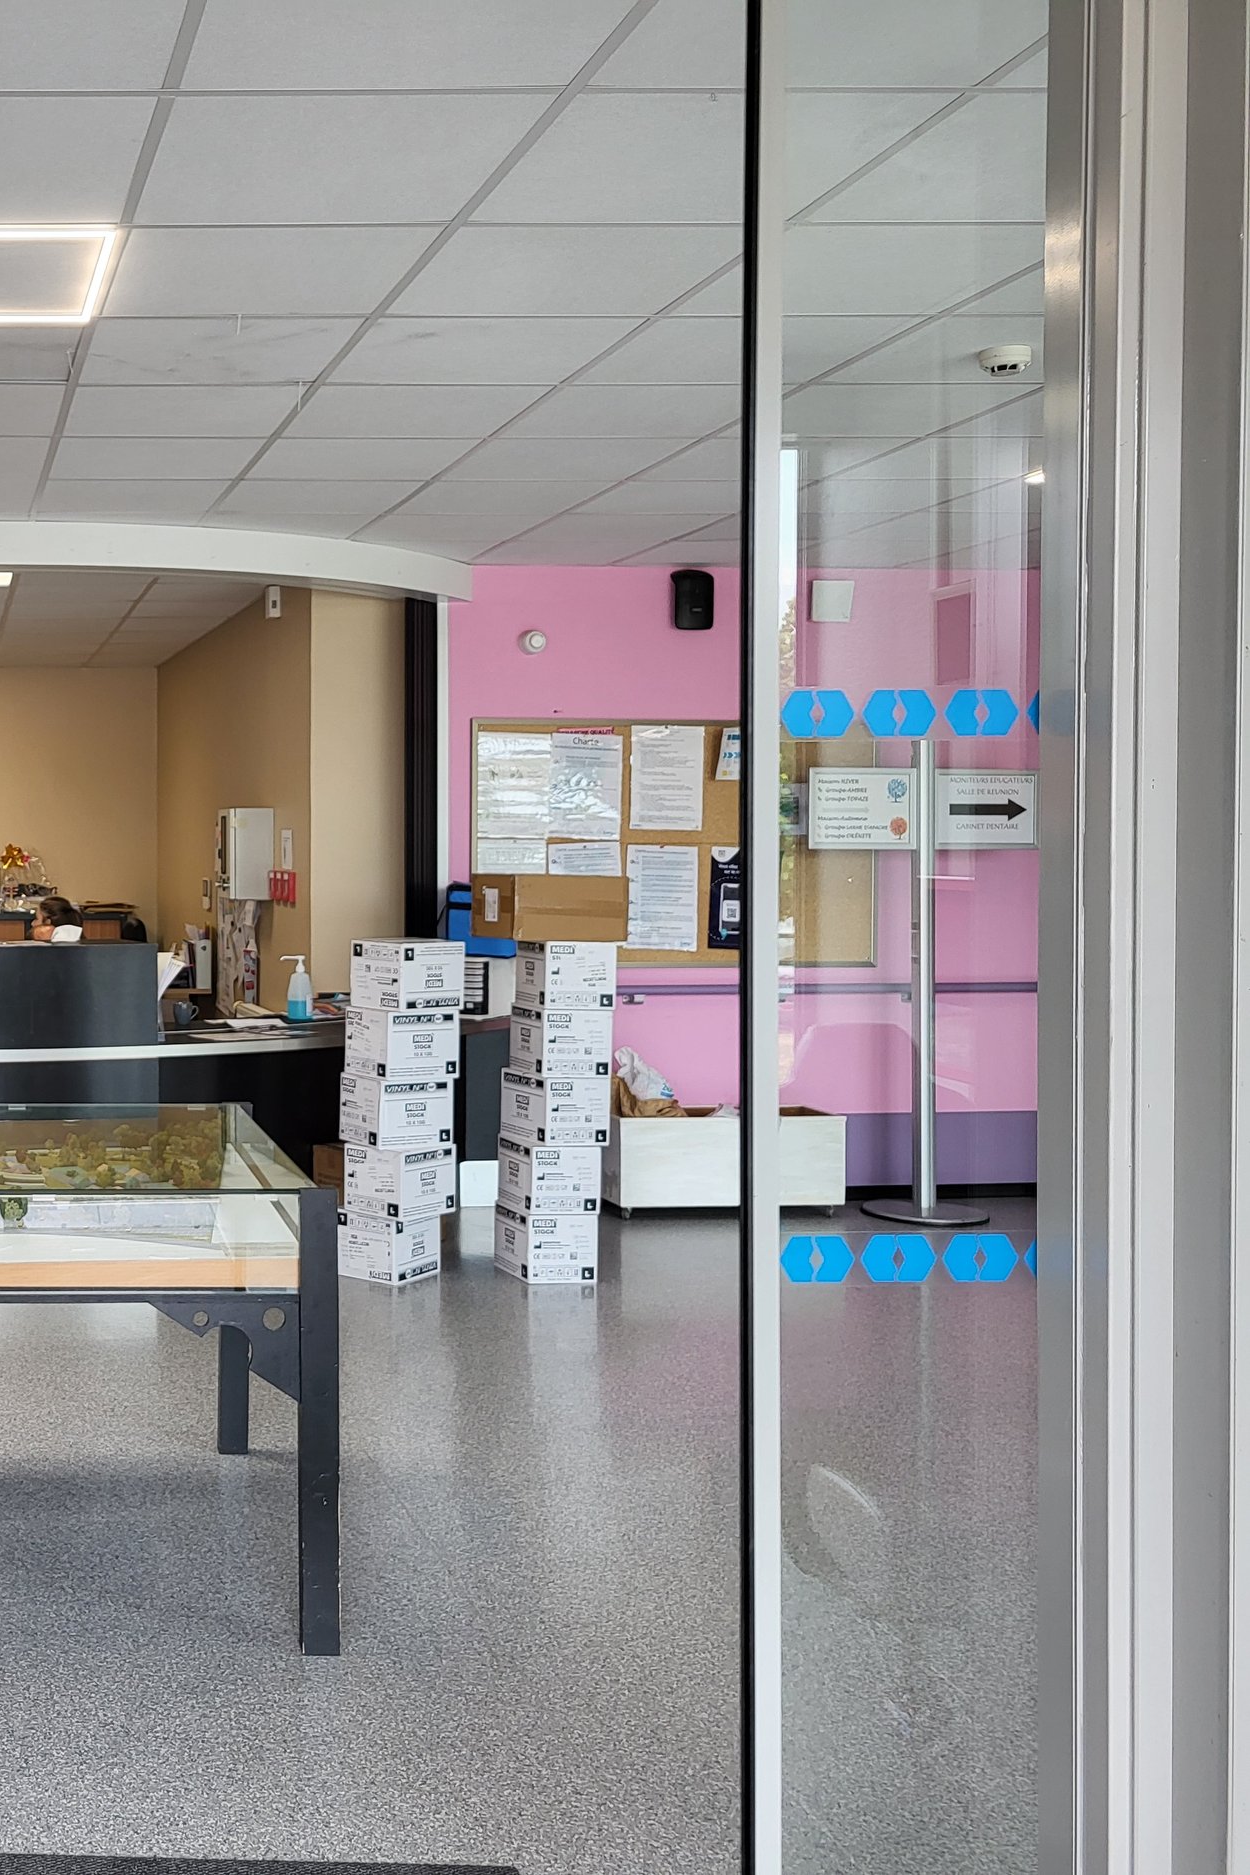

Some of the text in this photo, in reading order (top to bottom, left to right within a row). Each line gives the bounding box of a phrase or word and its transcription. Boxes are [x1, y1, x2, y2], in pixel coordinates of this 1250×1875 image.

[572, 737, 599, 746] Charte
[382, 999, 398, 1008] MEDI
[394, 1016, 419, 1024] VINYL
[549, 1014, 570, 1022] MEDI
[386, 1085, 411, 1094] VINYL
[348, 1149, 366, 1158] MEDI
